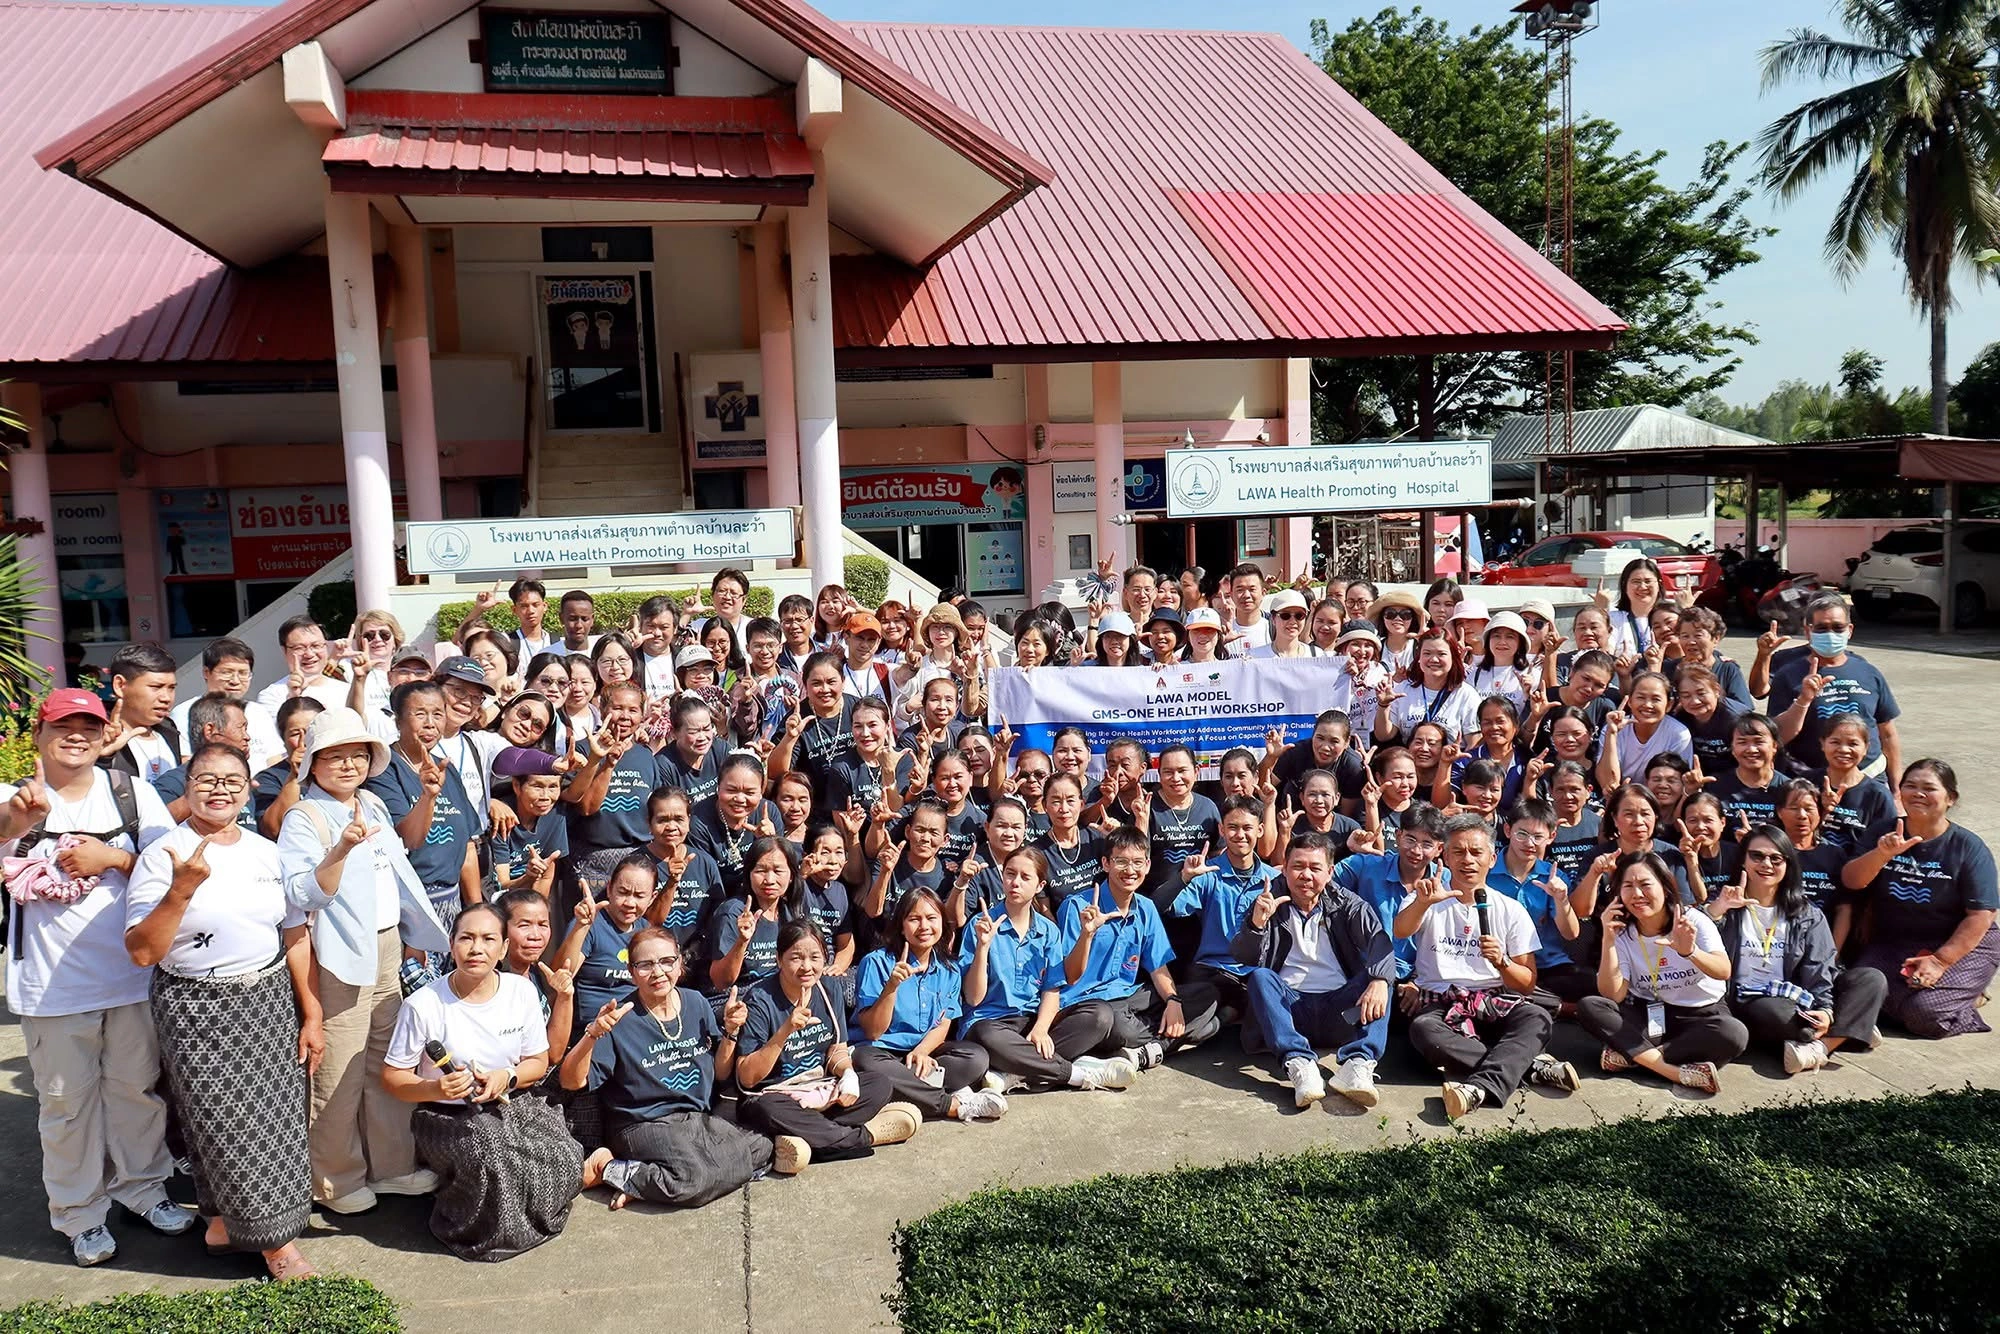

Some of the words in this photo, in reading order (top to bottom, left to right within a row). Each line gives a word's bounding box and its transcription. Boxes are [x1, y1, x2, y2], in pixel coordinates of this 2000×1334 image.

[1228, 450, 1483, 475] โรงพยาบาลส่งเสริมสุขภาพตำบลบ้านละว้า
[843, 477, 962, 501] ยินดีต้อนรับ
[1056, 491, 1086, 499] Consulting
[1237, 486, 1277, 501] LAWA
[1281, 484, 1325, 499] Health
[1328, 483, 1398, 499] Promoting
[1407, 480, 1460, 496] Hospital
[57, 503, 106, 519] room)
[82, 532, 122, 545] room)
[489, 519, 767, 544] โรงพยาบาลส่งเสริมสุขภาพตำบลบ้านละว้า
[513, 550, 556, 564] LAWA
[559, 548, 607, 562] Health
[611, 545, 685, 561] Promoting
[693, 542, 751, 558] Hospital
[1146, 693, 1185, 705] LAWA
[1187, 690, 1232, 703] MODEL
[1091, 707, 1155, 721] GMS-ONE
[1157, 704, 1208, 718] HEALTH
[1210, 702, 1286, 716] WORKSHOP
[1127, 729, 1151, 737] Health
[1151, 728, 1189, 737] Workforce
[1188, 727, 1196, 735] to
[1196, 726, 1225, 735] Address
[1226, 724, 1266, 733] Community
[1205, 734, 1227, 742] Focus
[618, 770, 642, 778] MODEL
[1160, 824, 1181, 832] LAWA
[1056, 866, 1077, 878] LAWA
[1076, 858, 1099, 873] MODEL
[1802, 871, 1830, 880] MODEL
[1664, 967, 1698, 982] MODEL
[648, 1039, 673, 1055] LAWA
